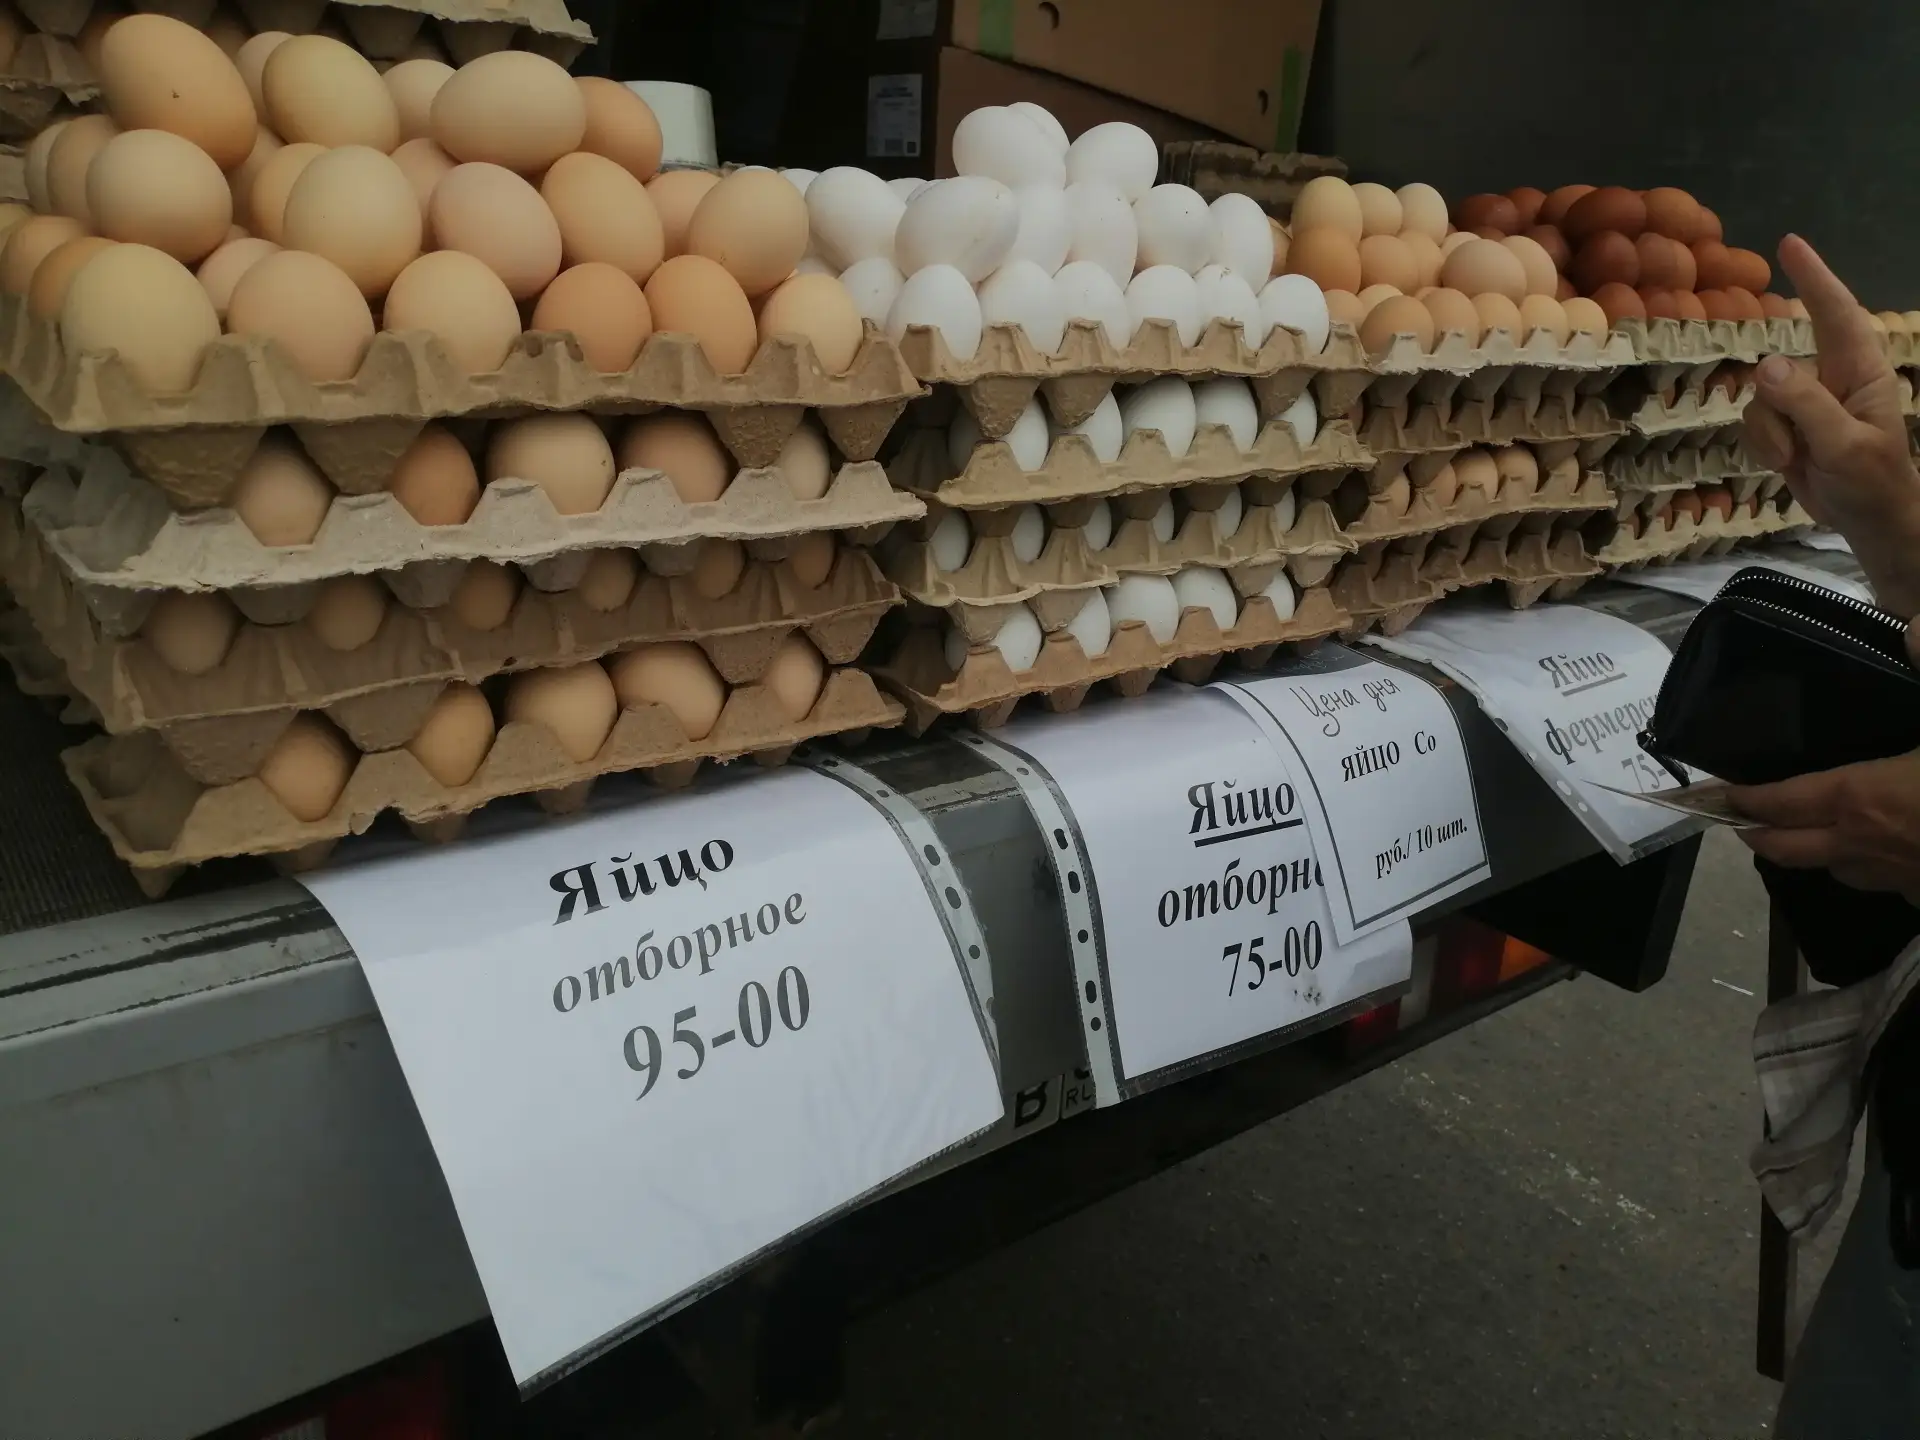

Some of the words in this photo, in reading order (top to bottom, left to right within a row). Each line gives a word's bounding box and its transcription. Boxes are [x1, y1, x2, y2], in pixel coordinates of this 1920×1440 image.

[1538, 652, 1615, 689] Яйцо
[1289, 687, 1360, 737] Цена
[1544, 695, 1657, 766] фермерс
[1187, 778, 1295, 835] Яйцо
[1621, 753, 1667, 794] 75-
[1416, 824, 1433, 854] 10
[1437, 817, 1468, 844] шт.
[550, 839, 734, 926] Яйцо
[1157, 857, 1324, 928] отборн
[552, 892, 807, 1013] отборное
[1222, 920, 1323, 997] 75-00
[623, 965, 810, 1102] 95-00
